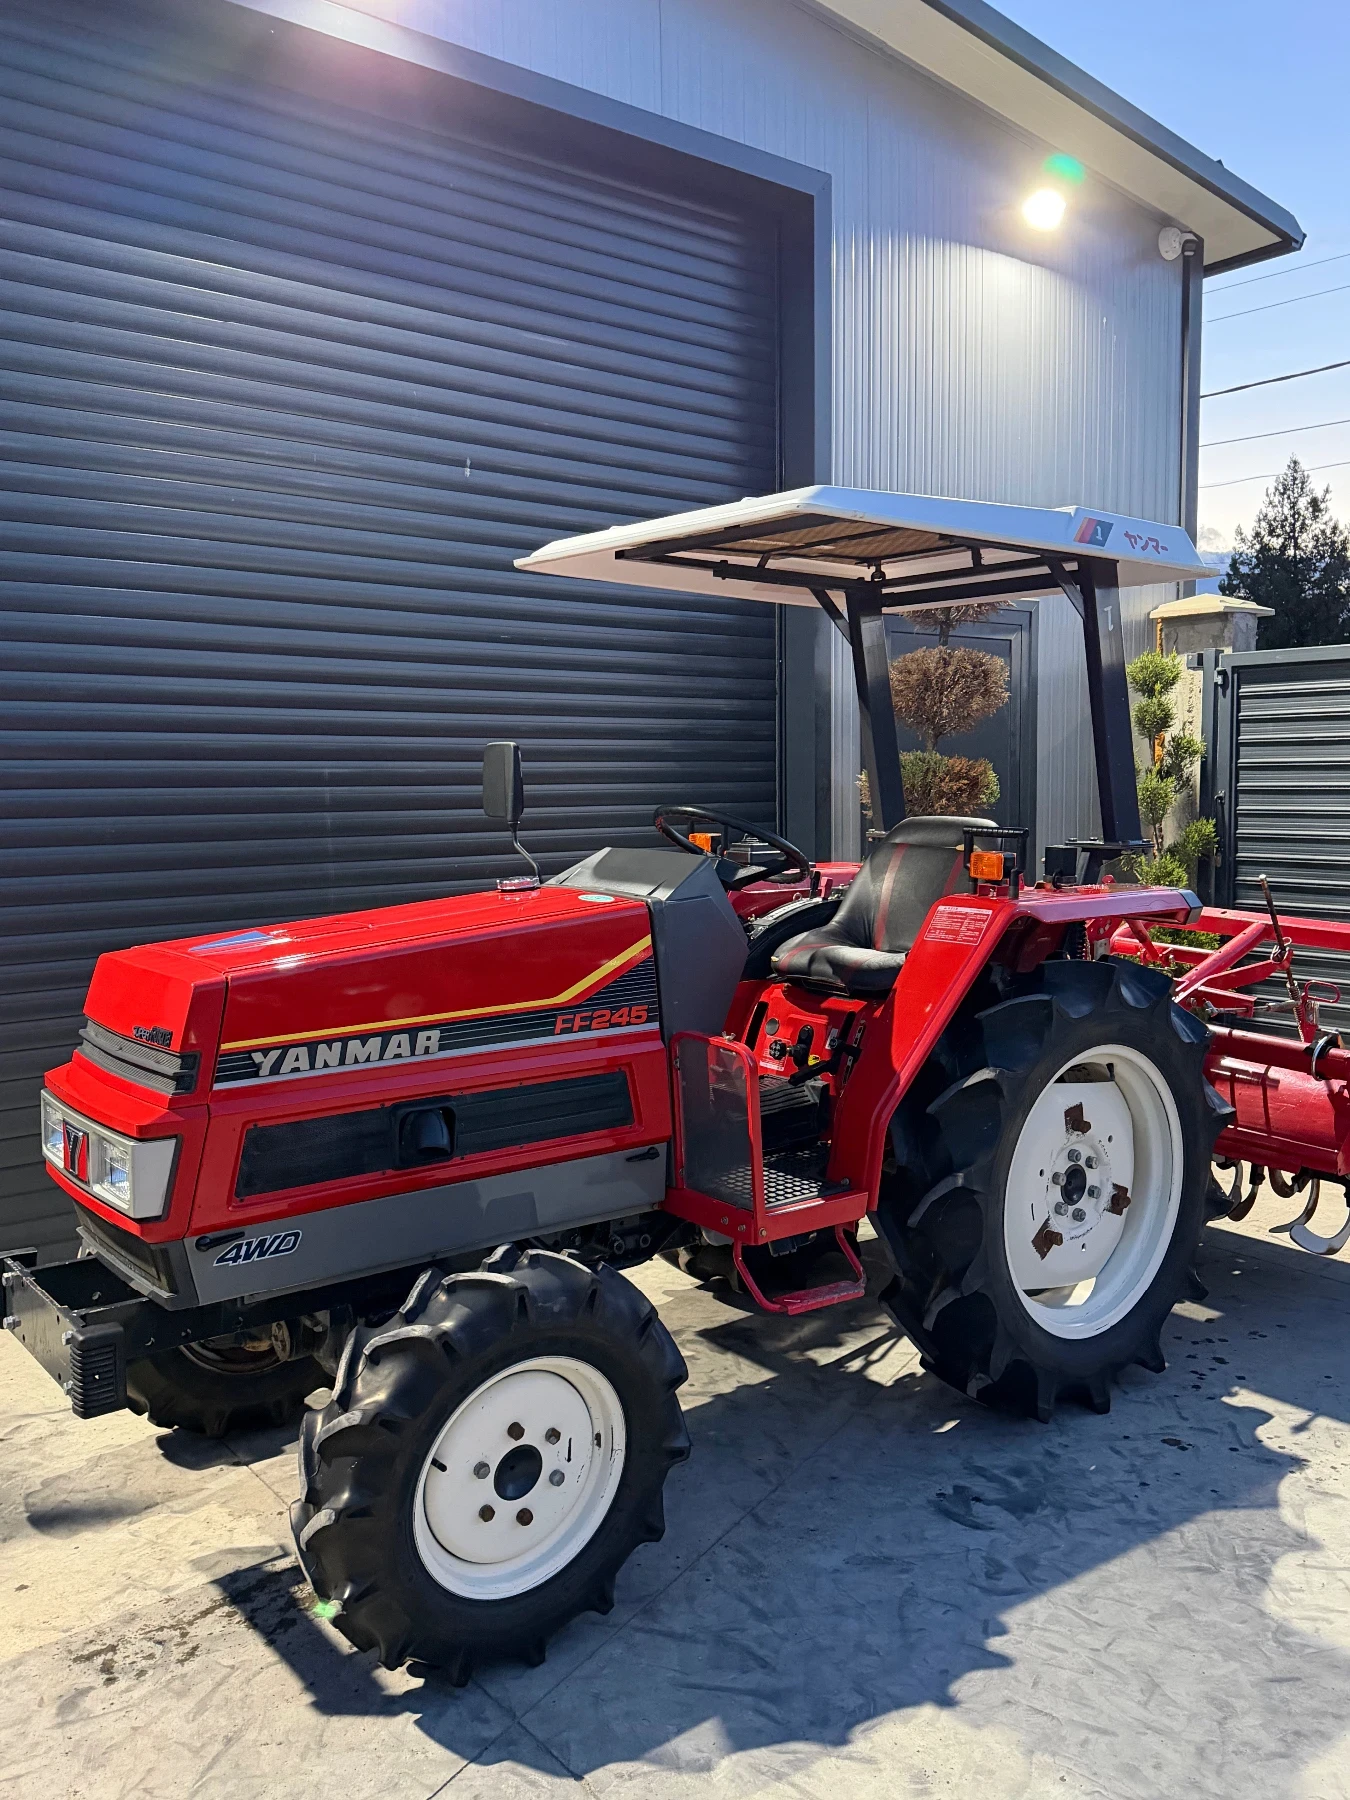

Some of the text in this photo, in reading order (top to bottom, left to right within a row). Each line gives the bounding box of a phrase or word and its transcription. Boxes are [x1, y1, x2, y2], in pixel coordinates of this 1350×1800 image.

[1123, 530, 1169, 555] ヤンマー
[554, 1004, 649, 1035] FF245
[250, 1029, 441, 1077] YANMAR
[213, 1229, 303, 1267] 4WD
